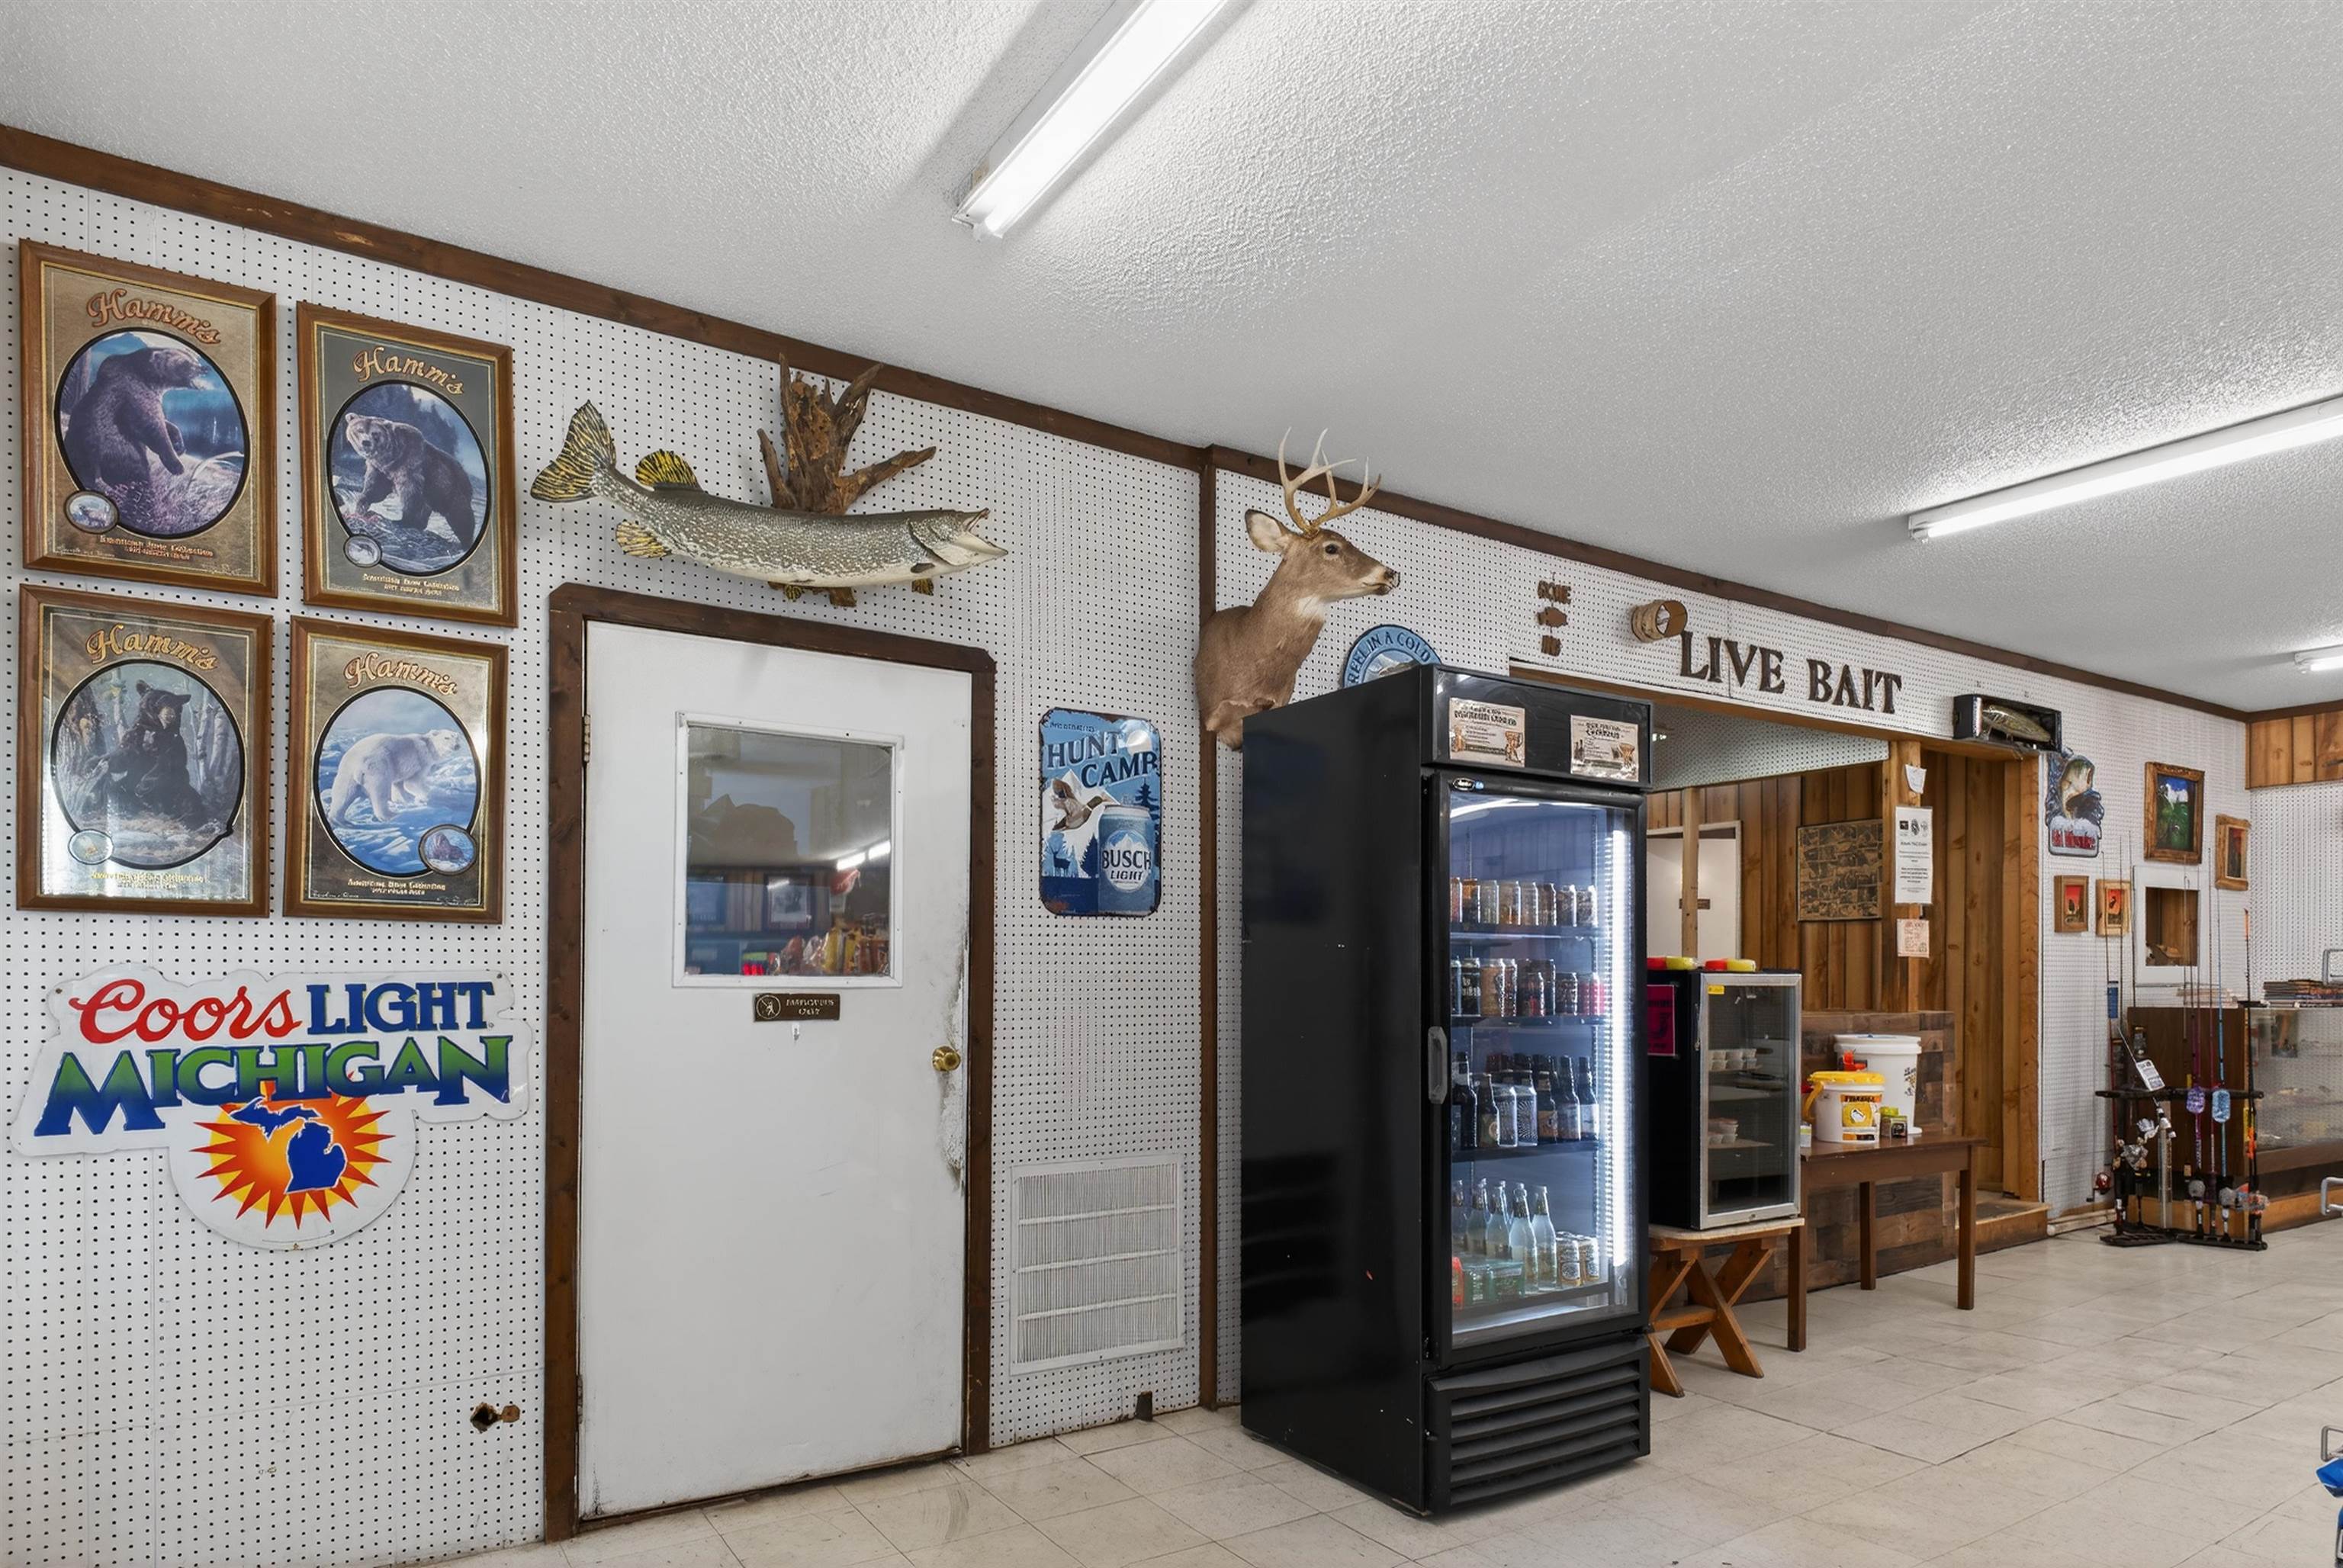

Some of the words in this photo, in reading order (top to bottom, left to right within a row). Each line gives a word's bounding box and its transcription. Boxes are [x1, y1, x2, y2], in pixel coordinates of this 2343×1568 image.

[86, 288, 221, 344] Hamm's
[353, 346, 464, 394] Hamm's
[85, 623, 218, 670] Hamm's
[1385, 631, 1393, 645] A
[1396, 631, 1431, 663] COLD
[344, 649, 458, 696] Hamm's
[1680, 631, 1785, 694] LIVE
[1807, 659, 1902, 714] BAIT
[1047, 730, 1123, 769] HUNT
[1102, 849, 1152, 870] BUSCH
[1110, 870, 1144, 881] LIGHT
[69, 978, 303, 1044] Coors
[307, 981, 495, 1035] LIGHT
[34, 1035, 513, 1137] MICHIGAN
